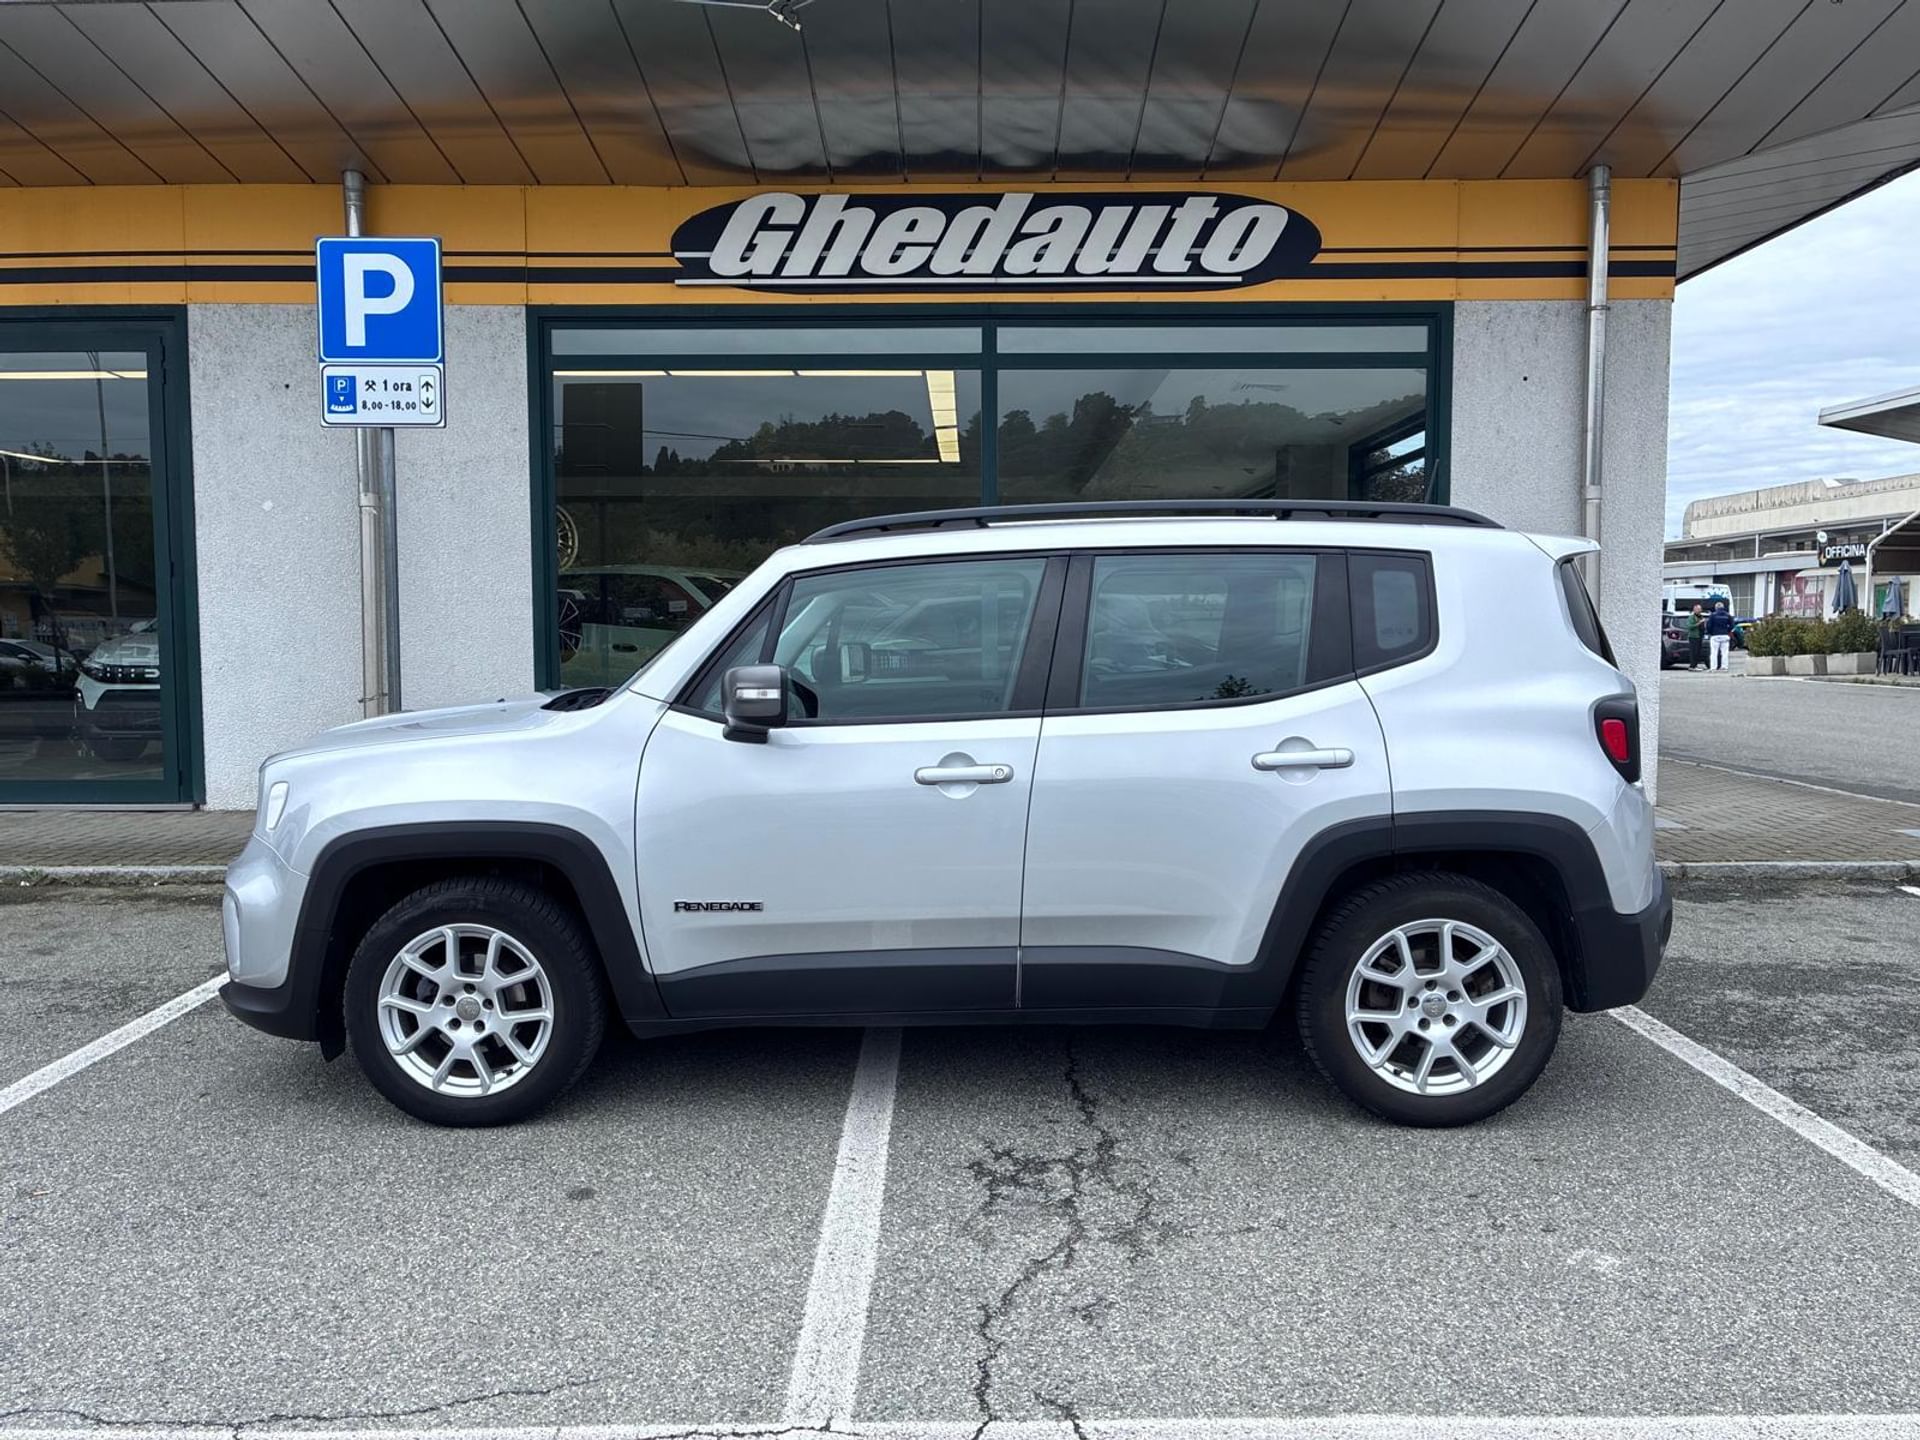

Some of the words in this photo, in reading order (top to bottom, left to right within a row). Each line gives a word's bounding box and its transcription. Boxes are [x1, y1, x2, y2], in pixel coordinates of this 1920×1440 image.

[709, 192, 1288, 276] Ghedauto
[343, 253, 415, 346] P
[337, 380, 346, 390] P
[383, 379, 388, 391] 1
[393, 382, 412, 392] ora
[1825, 544, 1866, 559] OFFICINA
[674, 901, 763, 912] RENEGADE
